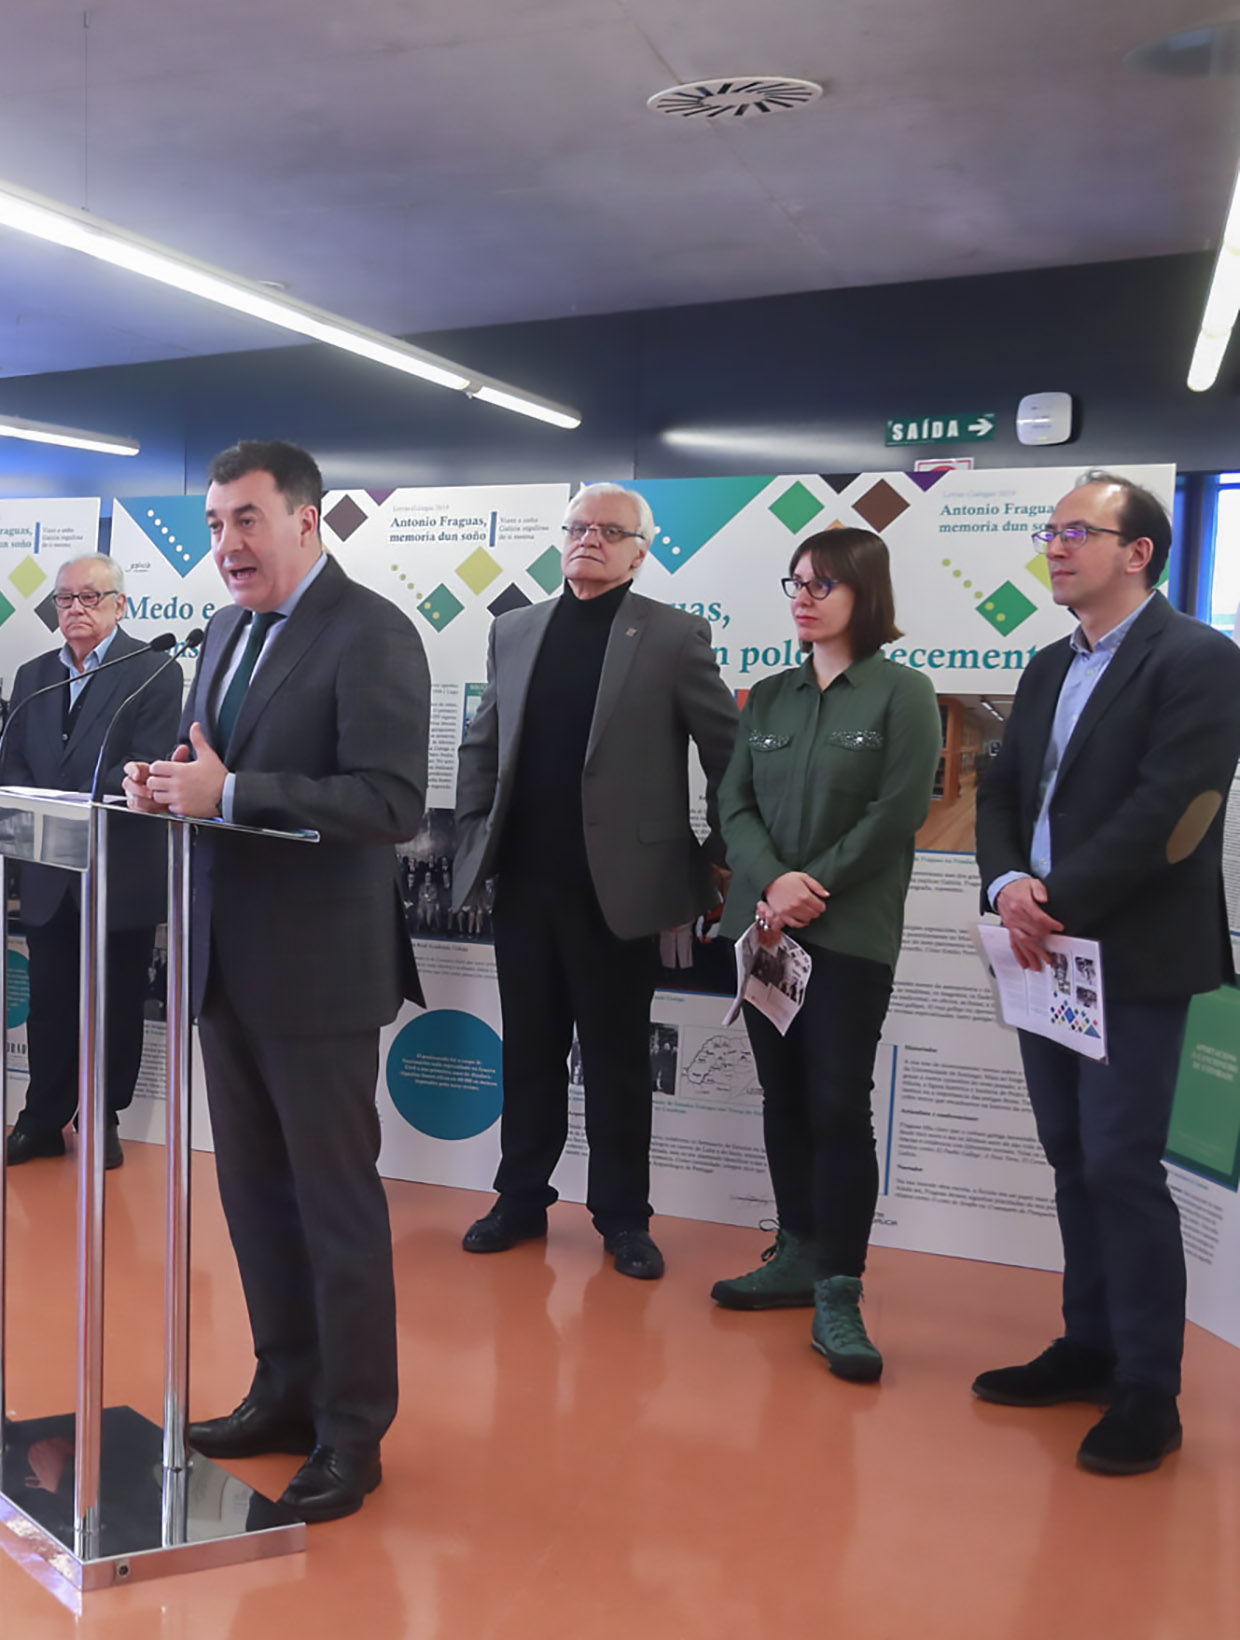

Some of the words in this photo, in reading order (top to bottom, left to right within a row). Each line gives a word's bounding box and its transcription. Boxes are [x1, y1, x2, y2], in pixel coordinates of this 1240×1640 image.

[892, 418, 960, 441] SAÍDA
[940, 503, 1000, 516] Antonio
[1004, 503, 1055, 517] Fragua
[391, 517, 437, 528] Antonio
[440, 516, 487, 528] Fraguas,
[939, 520, 999, 533] memoria
[1002, 521, 1028, 532] dun
[389, 532, 436, 542] memoria
[438, 531, 458, 541] dun
[461, 531, 487, 542] soño
[123, 595, 194, 620] Medo
[202, 603, 215, 620] e
